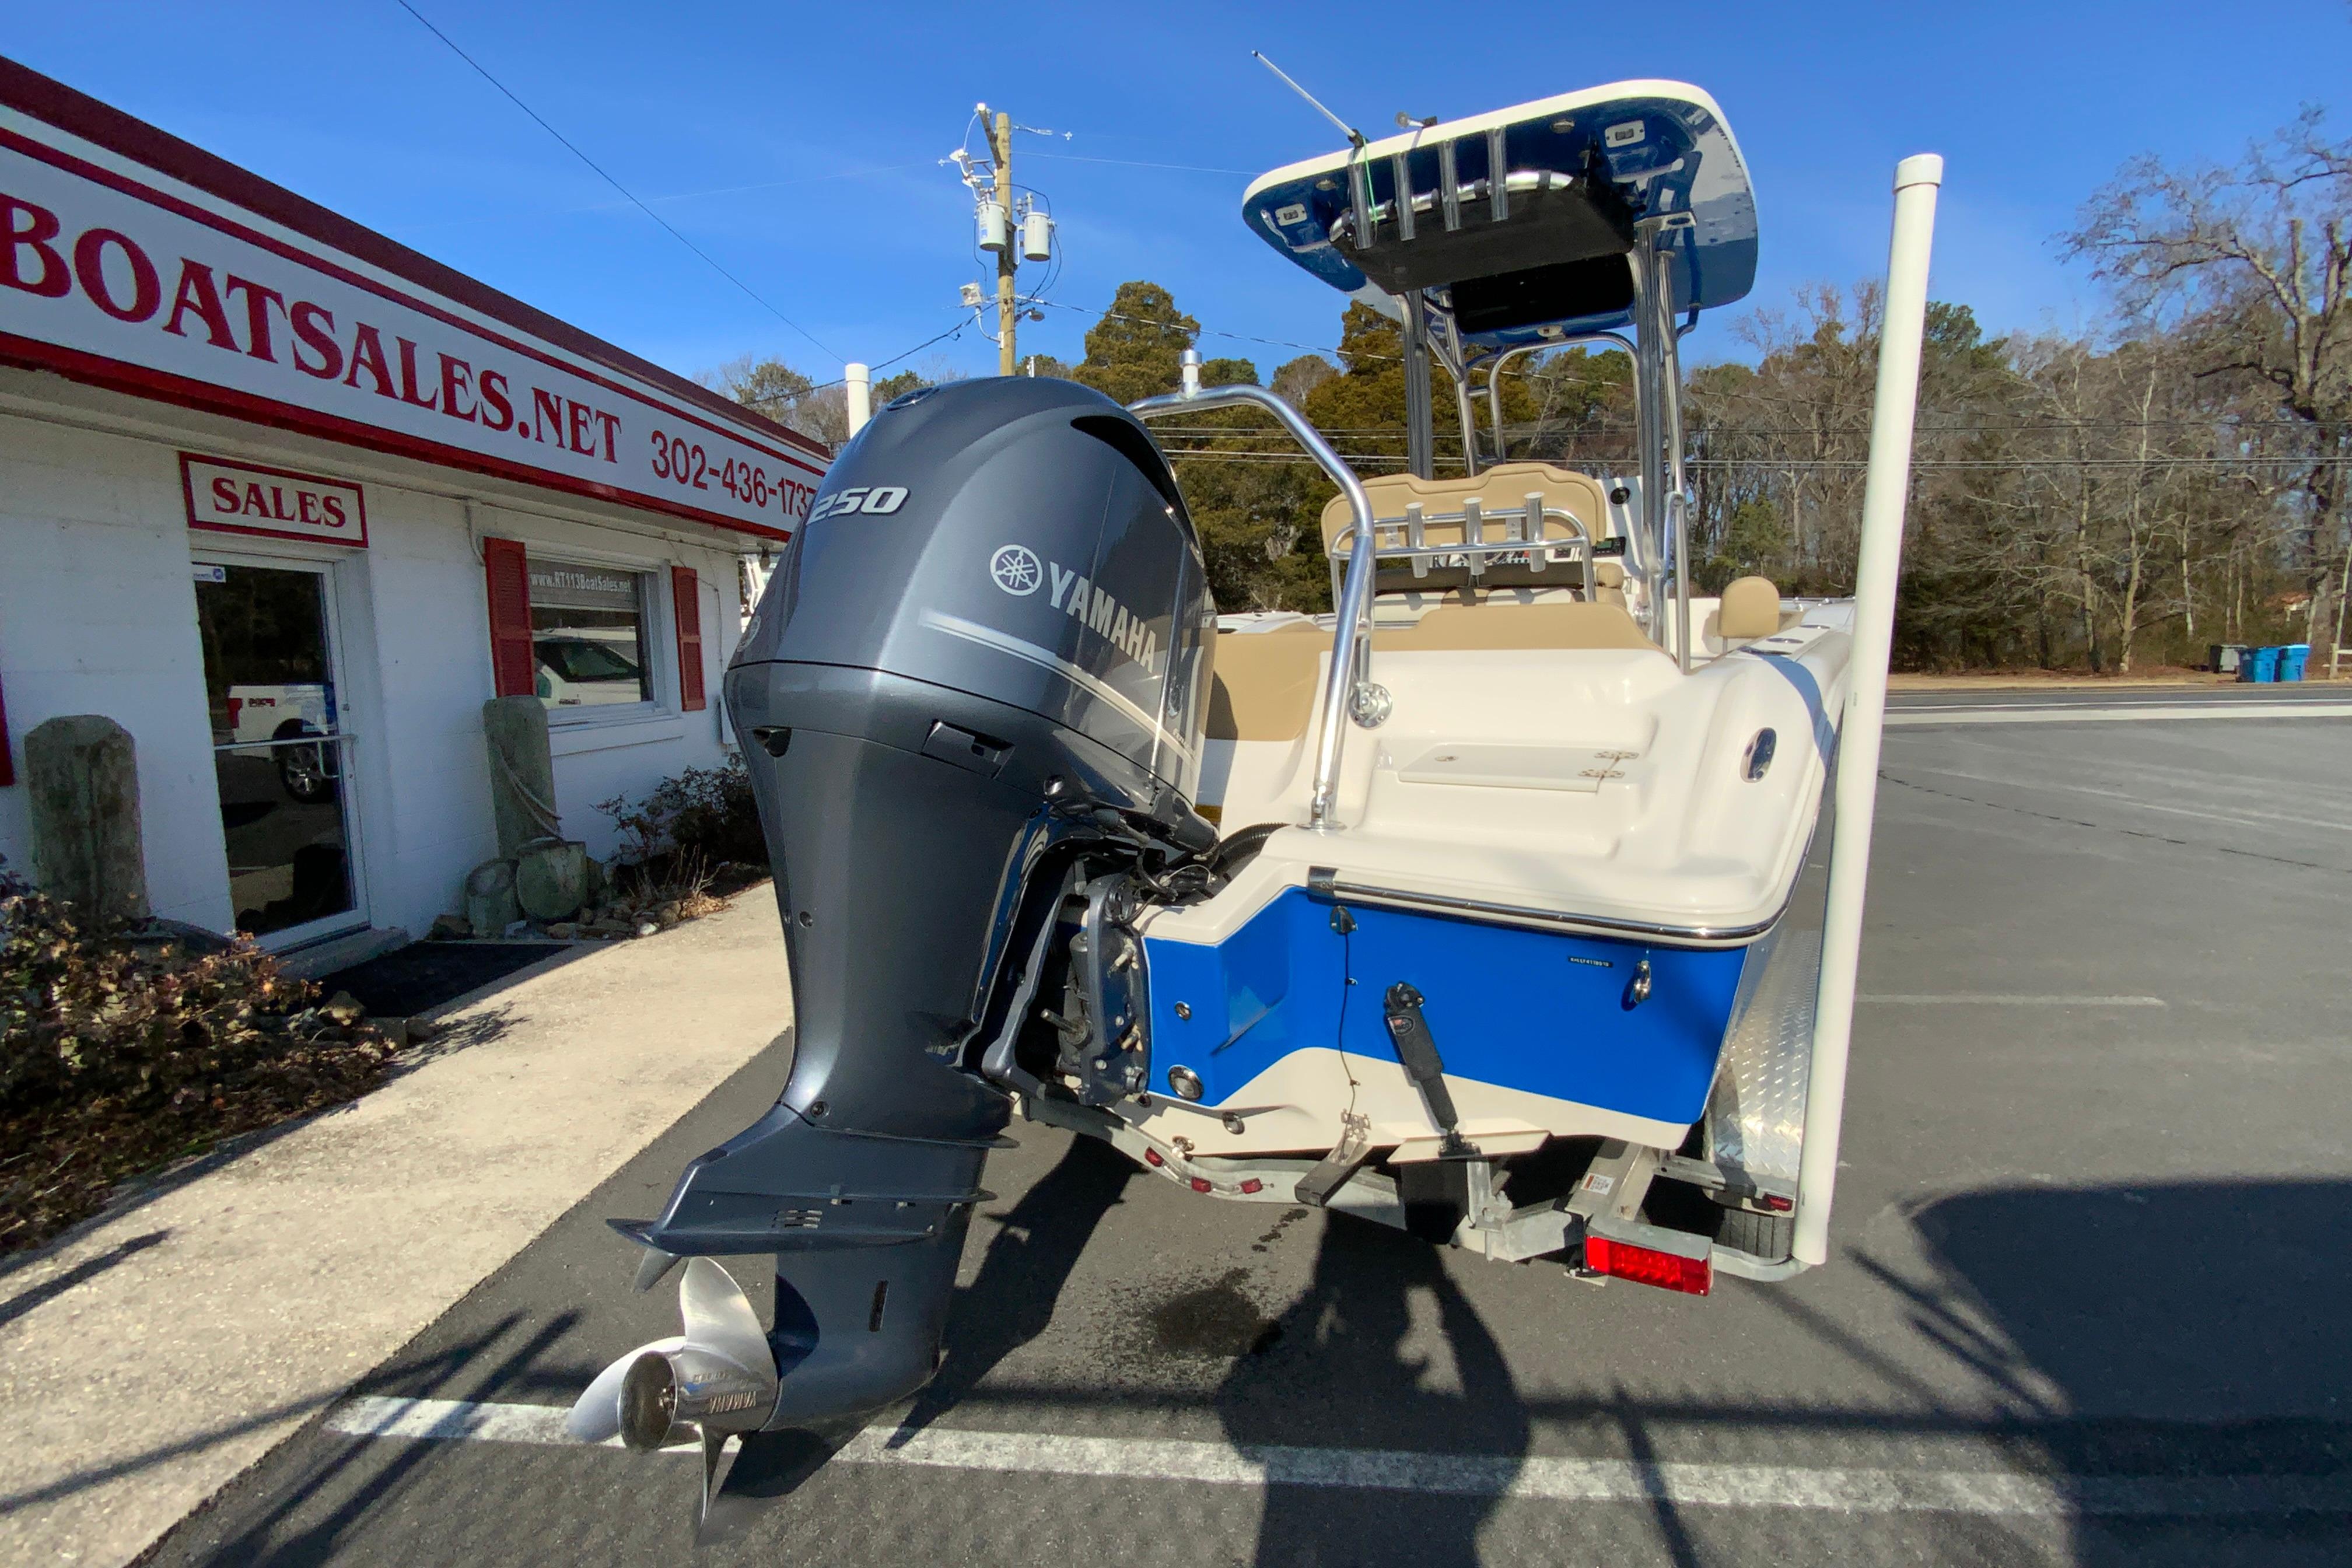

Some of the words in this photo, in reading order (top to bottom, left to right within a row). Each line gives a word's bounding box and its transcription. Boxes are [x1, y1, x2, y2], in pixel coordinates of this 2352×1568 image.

[0, 193, 622, 463] BOATSALES.NET
[212, 477, 346, 527] SALES
[806, 487, 908, 525] 250
[1049, 562, 1157, 673] YAMAHA
